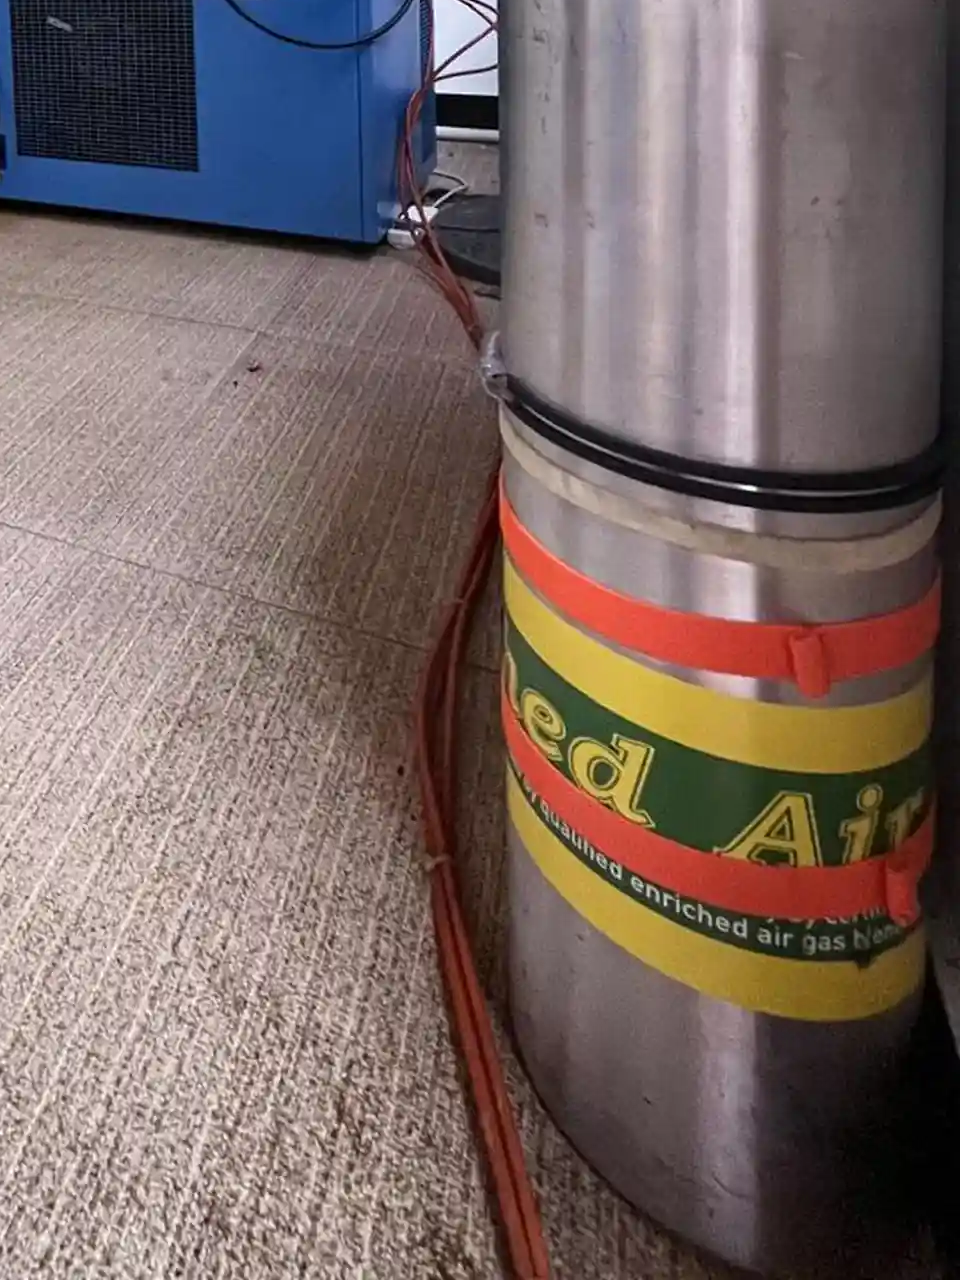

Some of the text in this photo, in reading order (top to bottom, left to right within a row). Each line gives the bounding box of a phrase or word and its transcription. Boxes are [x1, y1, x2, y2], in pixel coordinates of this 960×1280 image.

[630, 875, 749, 940] enriched
[757, 924, 794, 949] air
[802, 931, 846, 956] gas
